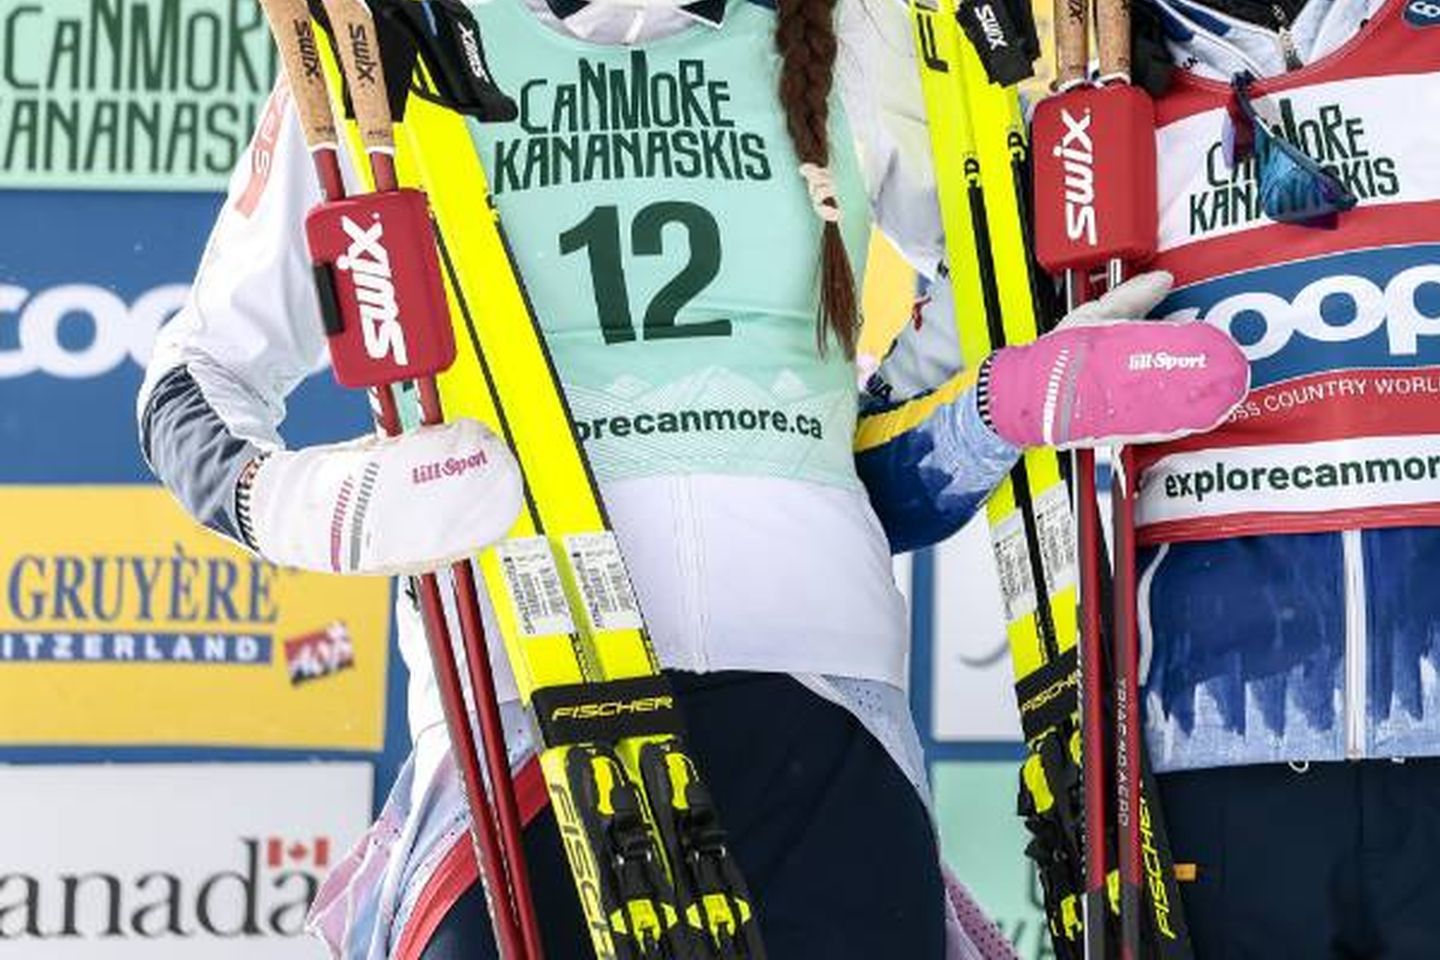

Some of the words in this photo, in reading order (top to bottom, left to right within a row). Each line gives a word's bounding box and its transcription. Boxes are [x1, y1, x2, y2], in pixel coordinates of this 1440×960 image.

[494, 129, 773, 196] KANANASKIS
[558, 199, 733, 345] 12
[1262, 377, 1367, 413] COUNTRY
[8, 543, 279, 624] GRUYÈRE
[551, 694, 674, 723] FISCHER
